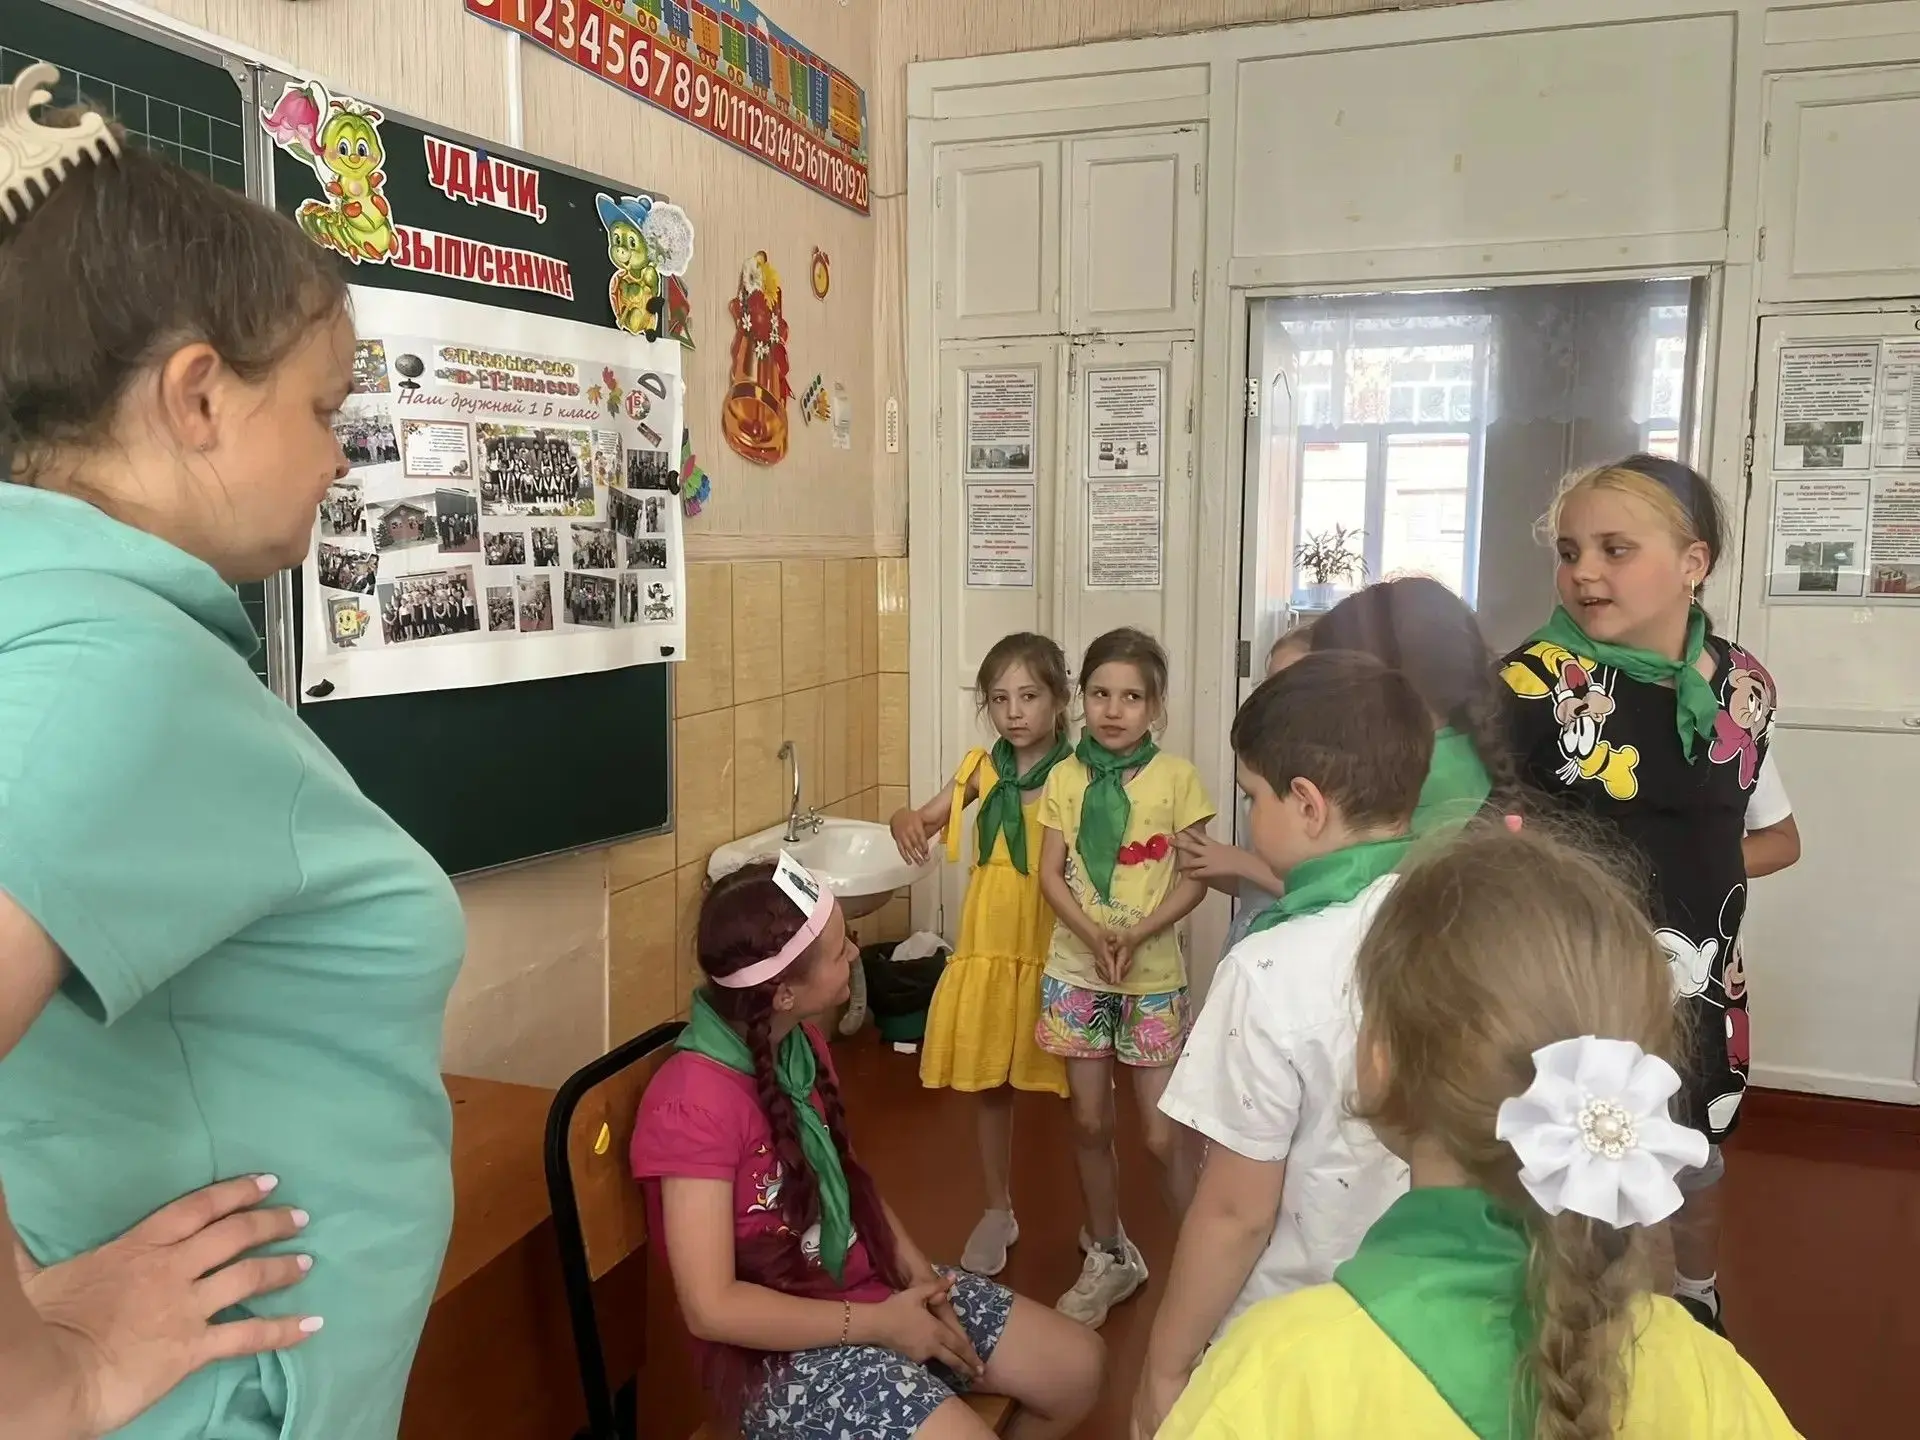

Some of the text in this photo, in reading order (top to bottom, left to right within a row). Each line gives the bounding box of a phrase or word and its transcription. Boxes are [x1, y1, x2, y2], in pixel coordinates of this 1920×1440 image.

[534, 0, 553, 38] 2
[558, 0, 576, 49] 3
[580, 13, 601, 64] 4
[606, 23, 625, 74] 5
[630, 40, 649, 87] 6
[654, 48, 671, 96] 7
[673, 62, 691, 109] 8
[694, 74, 710, 117] 9
[713, 85, 729, 130] 10
[730, 95, 746, 140] 11
[748, 105, 763, 150] 12
[763, 114, 777, 156] 13
[777, 123, 791, 166] 14
[791, 132, 805, 172] 15
[805, 141, 817, 180] 16
[817, 148, 829, 186] 17
[830, 157, 843, 194] 18
[843, 163, 855, 200] 19
[855, 170, 868, 207] 20
[426, 140, 544, 220] УДАЧИ,
[394, 227, 572, 297] ВЫПУСКНИК!
[397, 388, 600, 421] Наш дружный 1 Б класс
